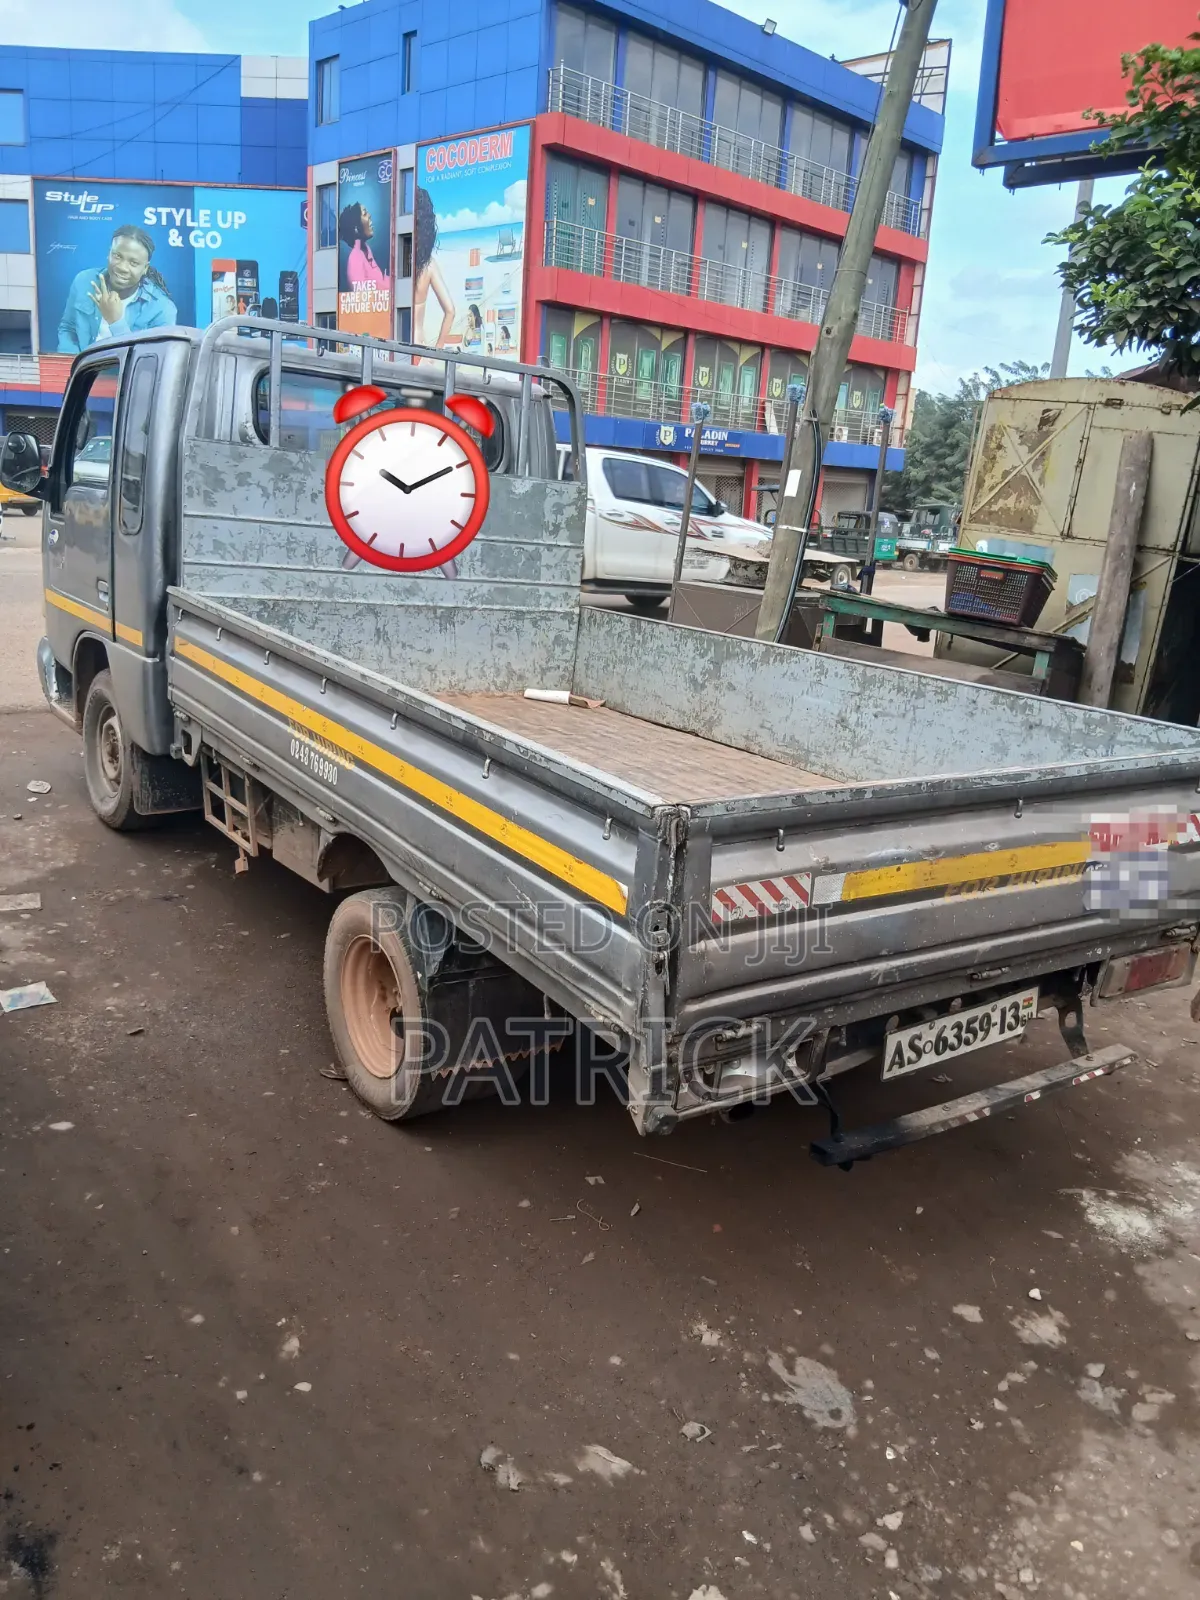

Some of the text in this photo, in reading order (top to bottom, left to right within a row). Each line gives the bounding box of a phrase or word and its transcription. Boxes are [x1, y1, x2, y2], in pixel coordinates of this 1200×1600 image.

[425, 130, 514, 173] COCODERM
[339, 167, 367, 184] Princess
[477, 161, 512, 174] COMPLEXION
[45, 190, 99, 205] Style
[80, 203, 115, 213] UP
[143, 206, 247, 230] STYLE UP
[168, 228, 222, 249] & GO
[352, 280, 377, 292] TAKES
[340, 290, 390, 303] CARE OF THE
[340, 301, 389, 314] FUTURE YOU
[700, 439, 719, 447] URKEY
[290, 738, 338, 786] 0243769930
[944, 876, 1000, 902] FOR
[1007, 862, 1087, 892] HIRIN
[886, 1031, 923, 1073] AS
